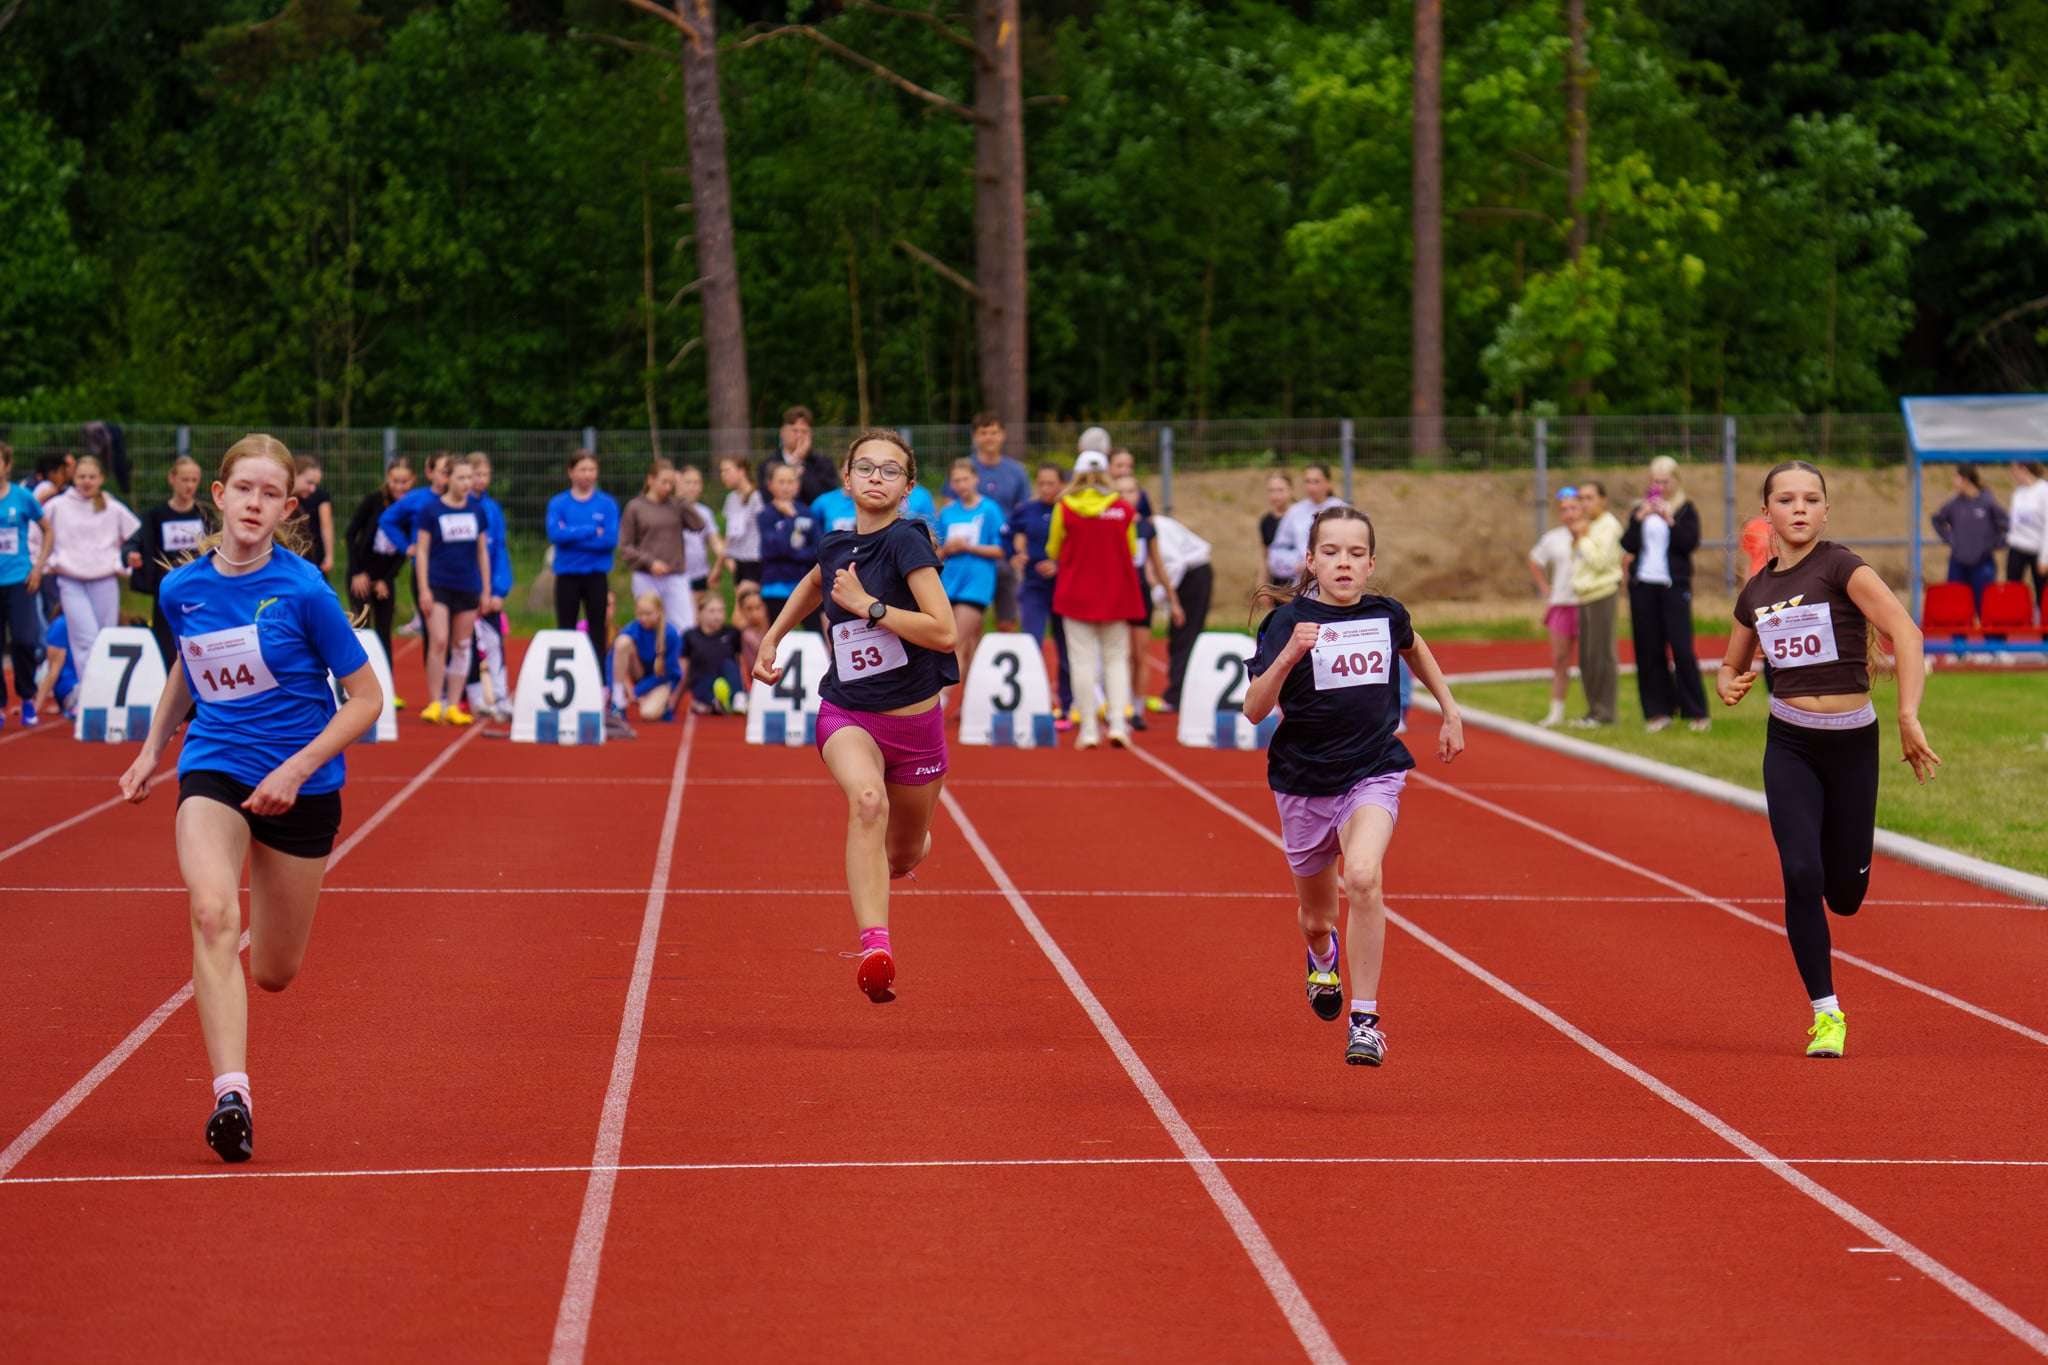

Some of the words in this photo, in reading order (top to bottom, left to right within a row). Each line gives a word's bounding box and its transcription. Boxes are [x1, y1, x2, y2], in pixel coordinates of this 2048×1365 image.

[109, 644, 143, 708] 7
[851, 646, 883, 671] 53
[1331, 650, 1384, 677] 402
[1774, 634, 1821, 660] 550
[203, 663, 255, 691] 144
[543, 648, 575, 710] 5
[773, 649, 807, 711] 4
[991, 651, 1021, 712] 3
[1215, 652, 1244, 711] 2
